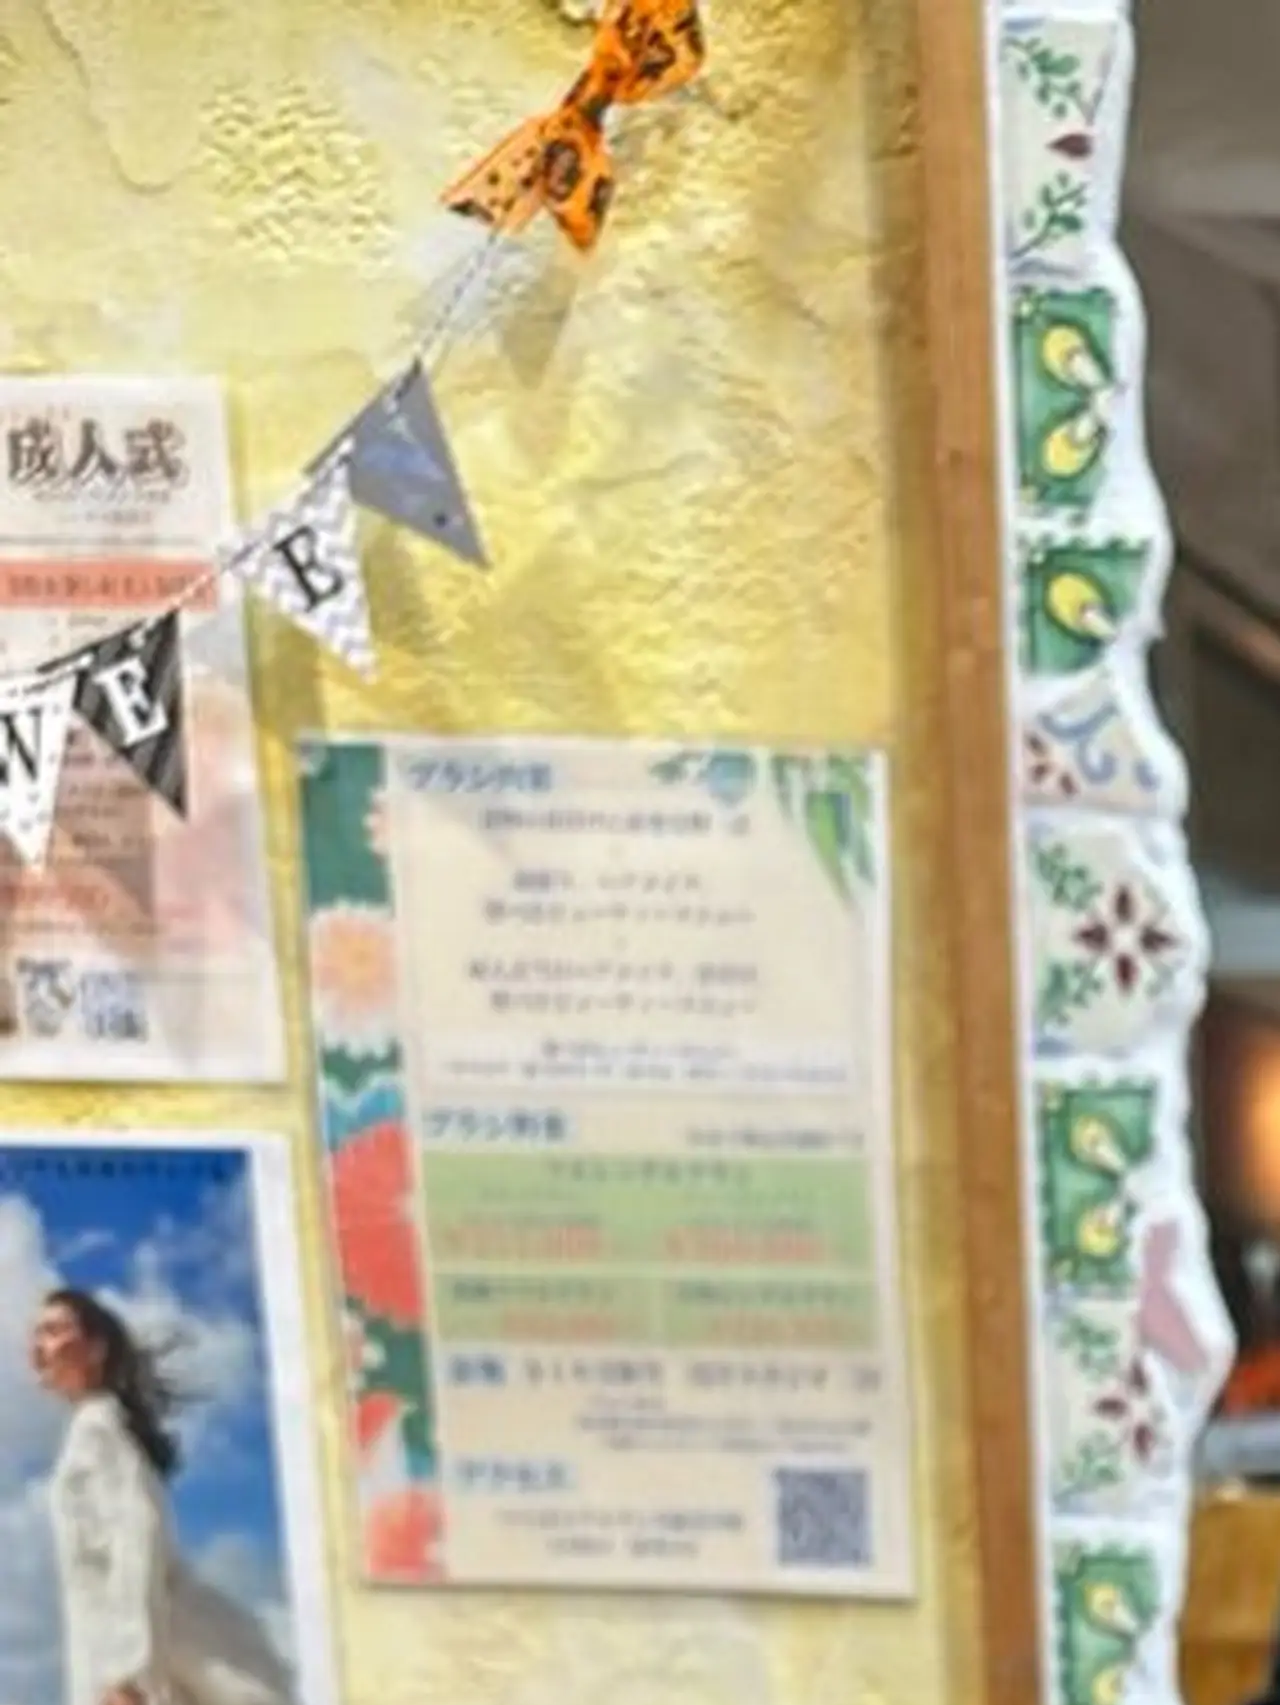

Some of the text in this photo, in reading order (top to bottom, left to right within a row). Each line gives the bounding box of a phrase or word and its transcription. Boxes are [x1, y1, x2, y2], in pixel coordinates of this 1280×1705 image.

[7, 418, 188, 482] 成人式
[93, 656, 170, 747] E
